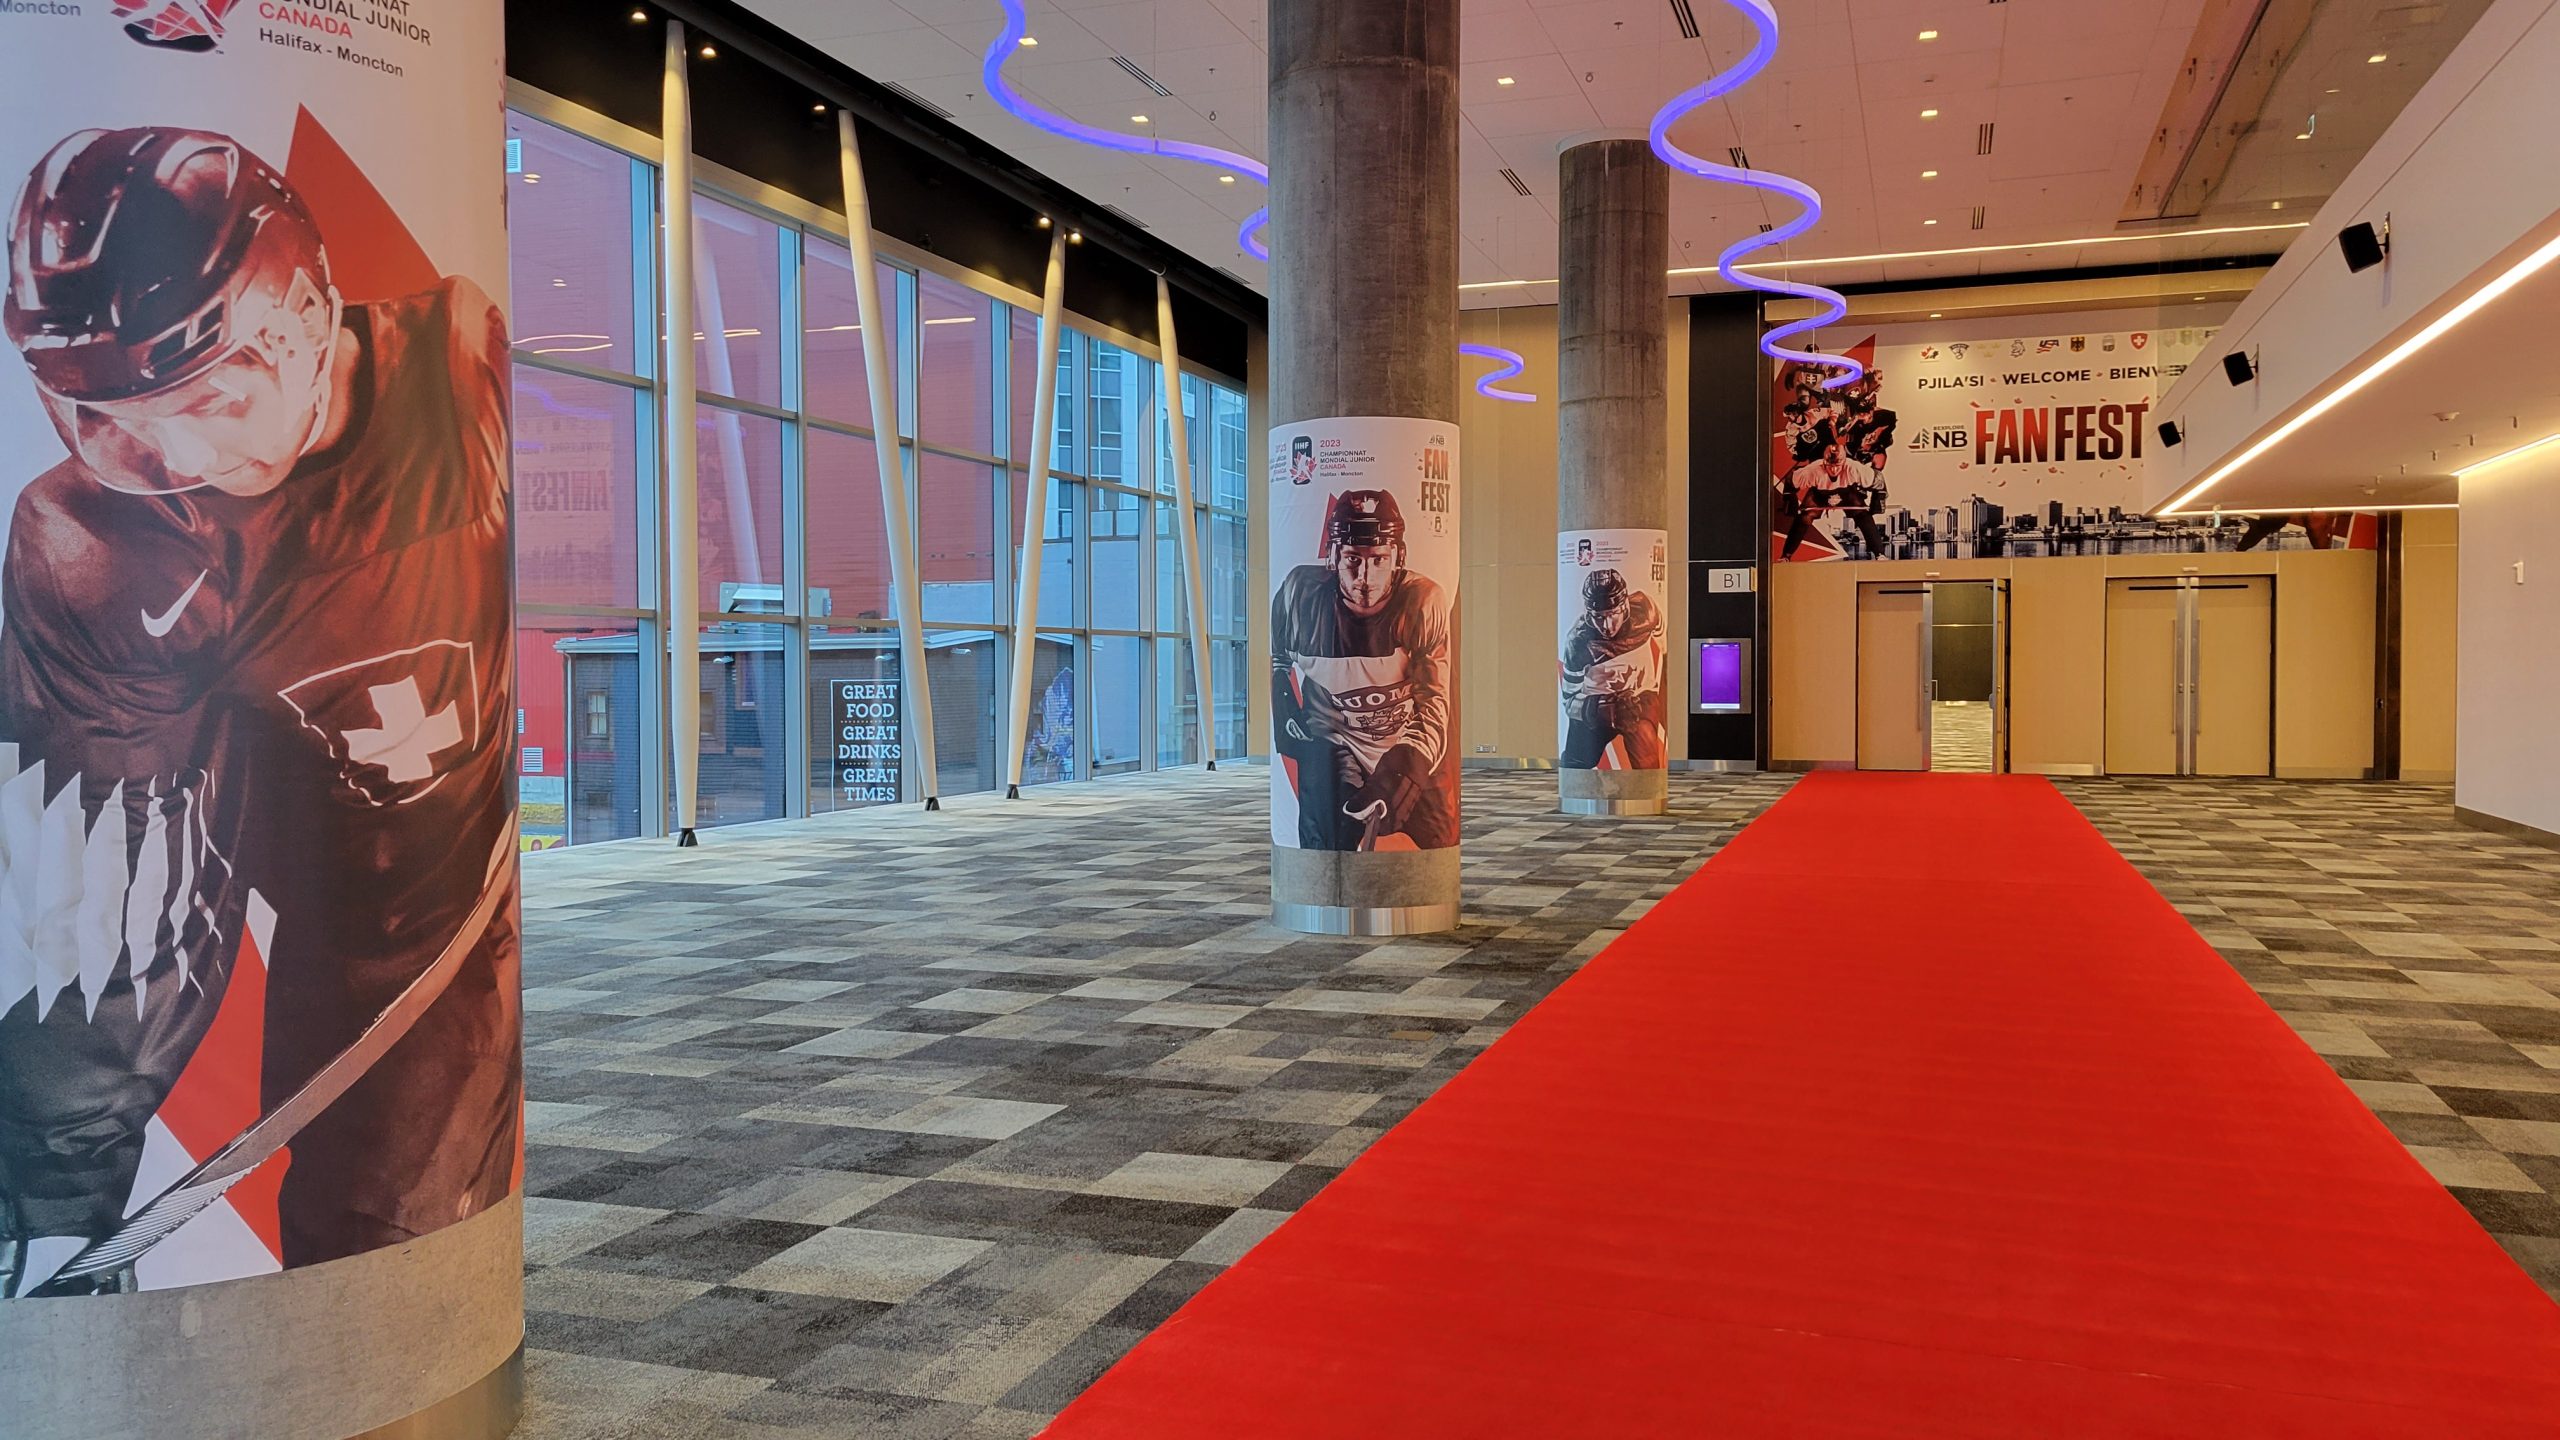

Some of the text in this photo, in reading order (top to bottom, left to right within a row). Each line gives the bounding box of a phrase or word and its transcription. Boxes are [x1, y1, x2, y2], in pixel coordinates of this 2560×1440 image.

[259, 2, 353, 39] CANADA
[365, 10, 431, 46] JUNIOR
[259, 28, 322, 54] Halifax
[337, 46, 403, 77] Moncton
[2038, 339, 2060, 348] USA
[1918, 375, 1984, 390] PJILA'SI
[2002, 369, 2091, 385] WELCOME
[1294, 442, 1310, 450] IIHF
[1320, 439, 1341, 448] 2023
[1933, 430, 1968, 449] NB
[1320, 450, 1367, 458] CHAMPIONNAT
[1424, 447, 1449, 481] FAN
[1421, 481, 1451, 514] FEST
[1724, 573, 1741, 589] B1
[842, 684, 897, 700] GREAT
[846, 703, 895, 718] FOOD
[842, 725, 898, 741] GREAT
[838, 744, 901, 759] DRINKS
[842, 768, 898, 783] GREAT
[844, 787, 896, 802] TIMES
